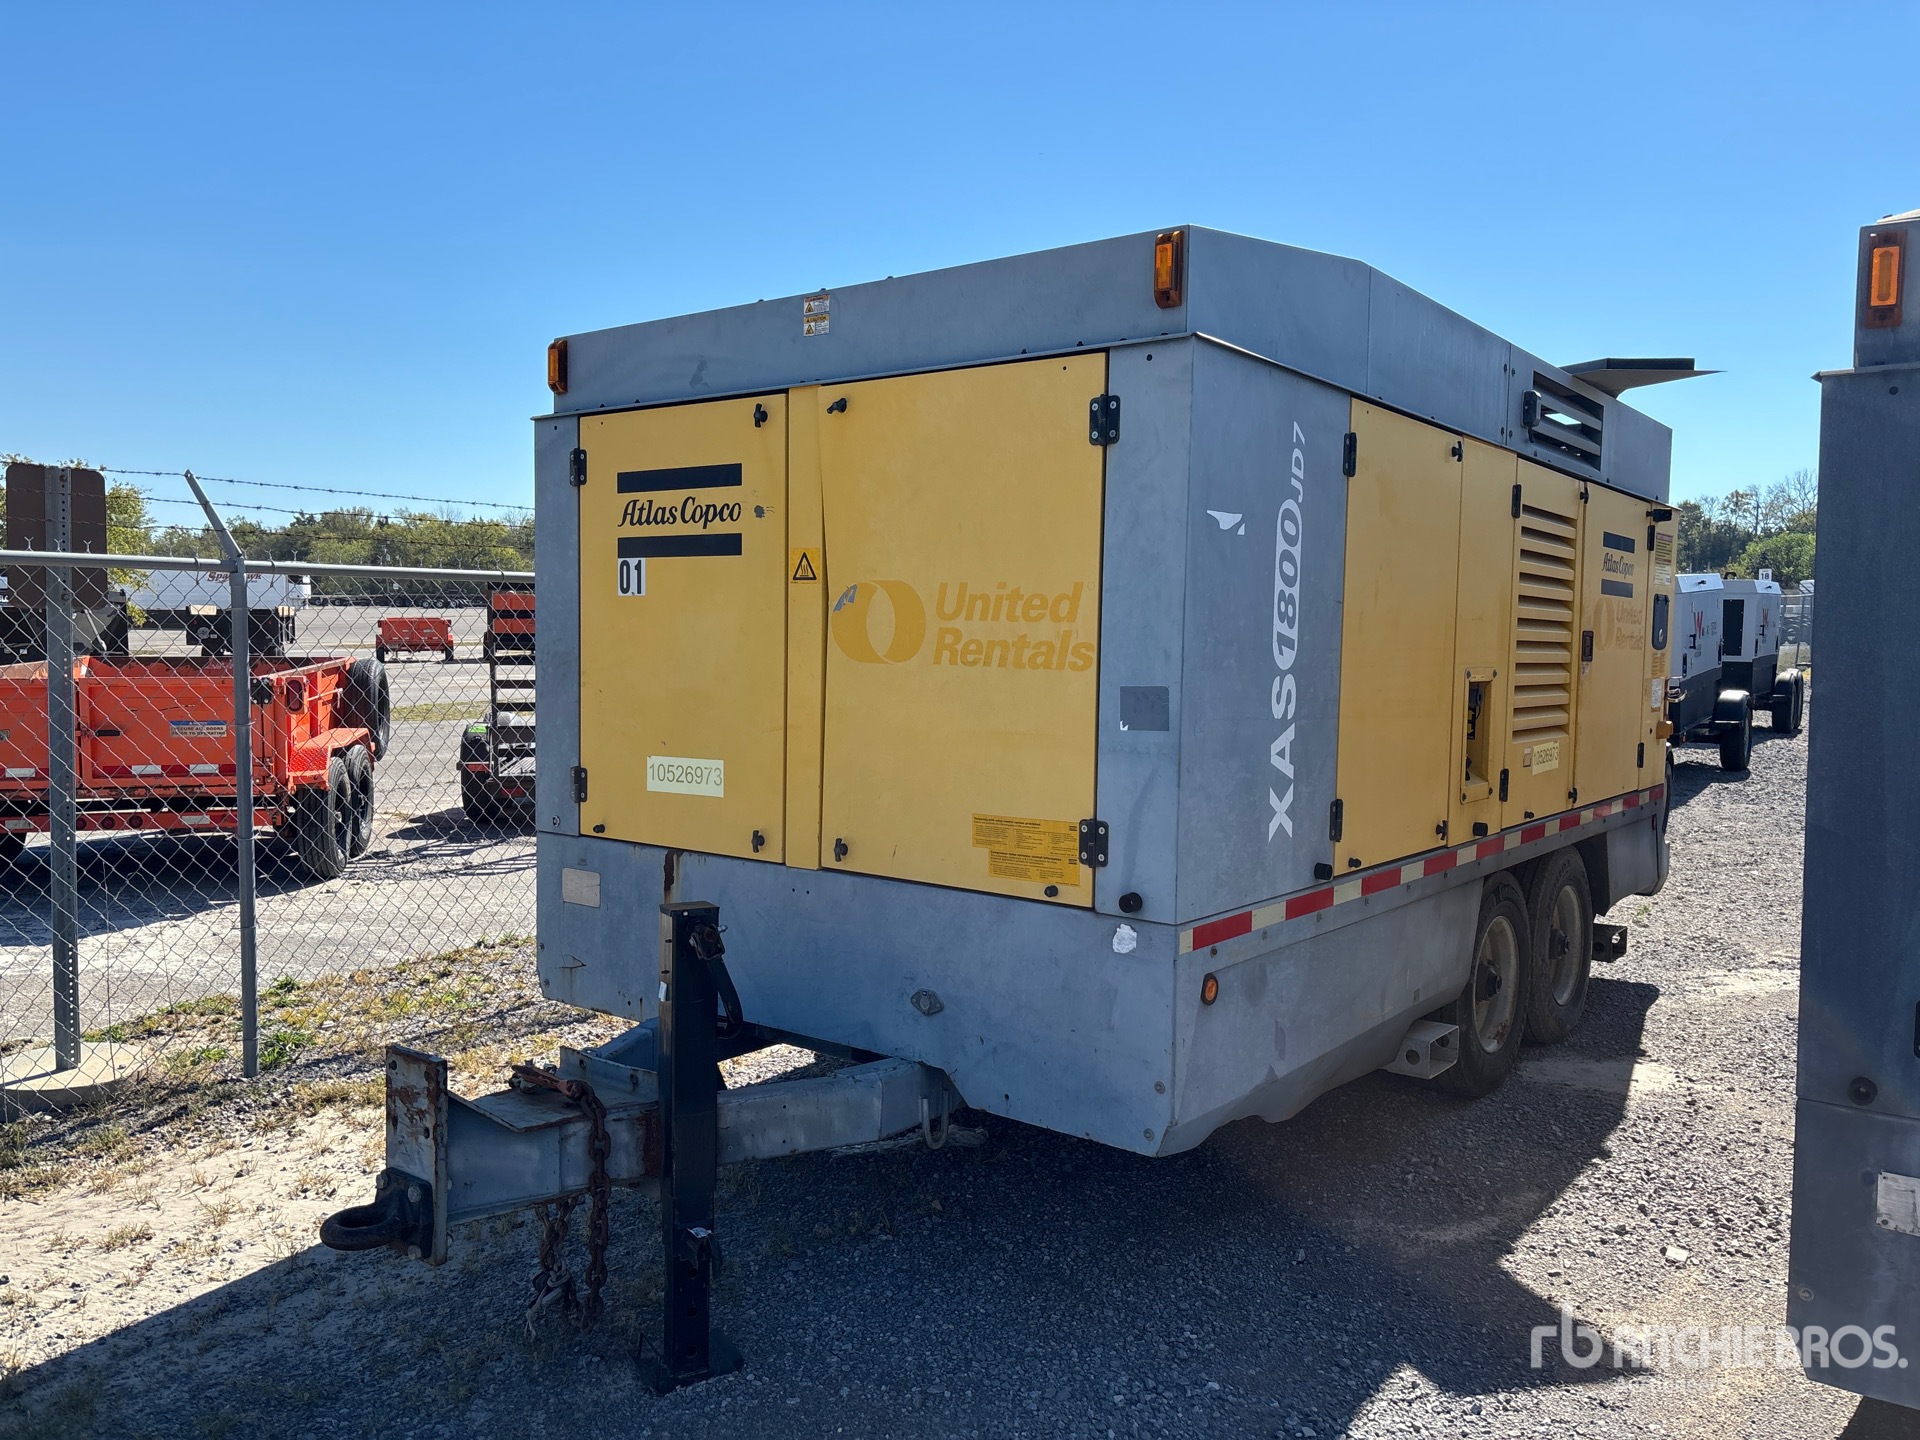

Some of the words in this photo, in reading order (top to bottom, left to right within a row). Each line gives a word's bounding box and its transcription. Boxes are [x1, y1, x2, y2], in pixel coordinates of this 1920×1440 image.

[617, 499, 677, 527] Atlas
[680, 495, 742, 530] Copco
[619, 559, 642, 595] 01
[1601, 552, 1620, 576] Atlas
[1761, 572, 1770, 580] 18
[935, 581, 1085, 624] United
[932, 626, 1096, 672] Rentals
[648, 762, 723, 787] 10526973
